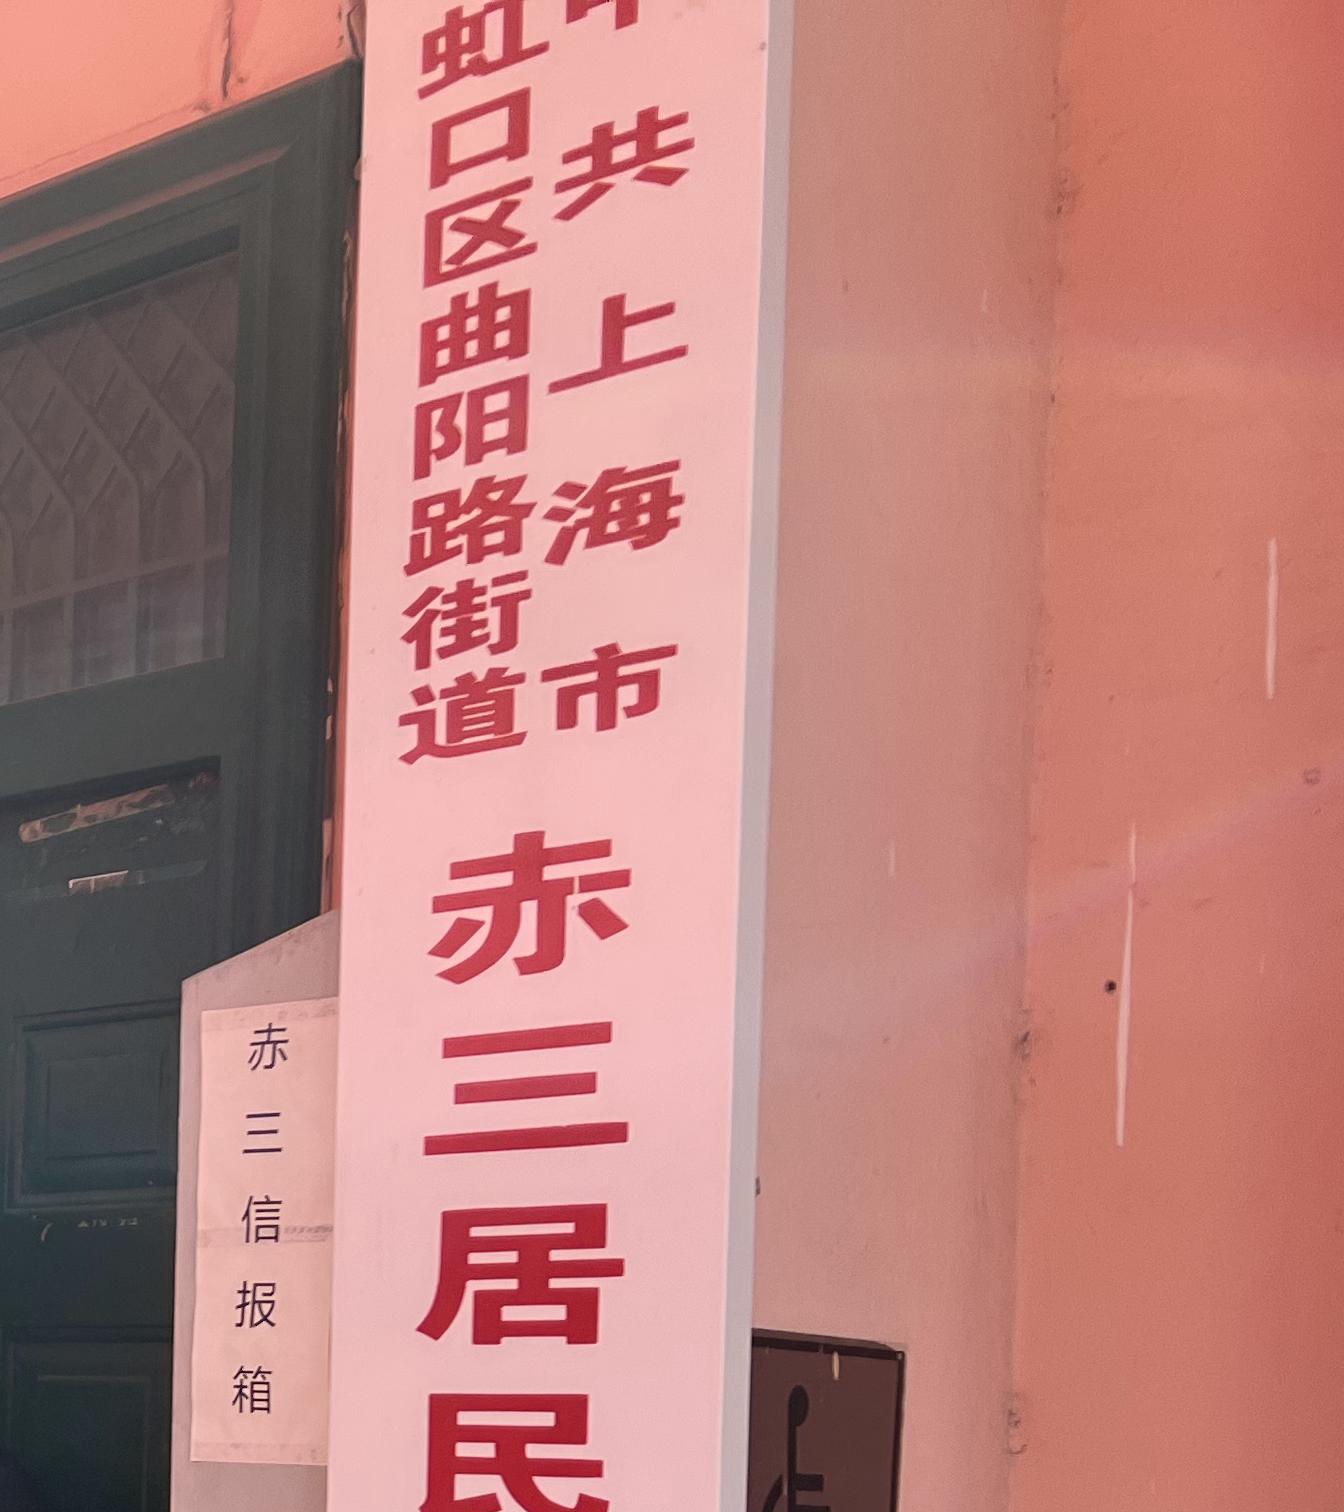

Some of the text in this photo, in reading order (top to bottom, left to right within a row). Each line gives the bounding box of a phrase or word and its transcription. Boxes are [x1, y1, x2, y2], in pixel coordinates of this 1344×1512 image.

[398, 0, 549, 765] 虹口区曲阳路街道
[542, 0, 694, 732] 共上海市
[231, 1022, 290, 1415] 赤三信报箱
